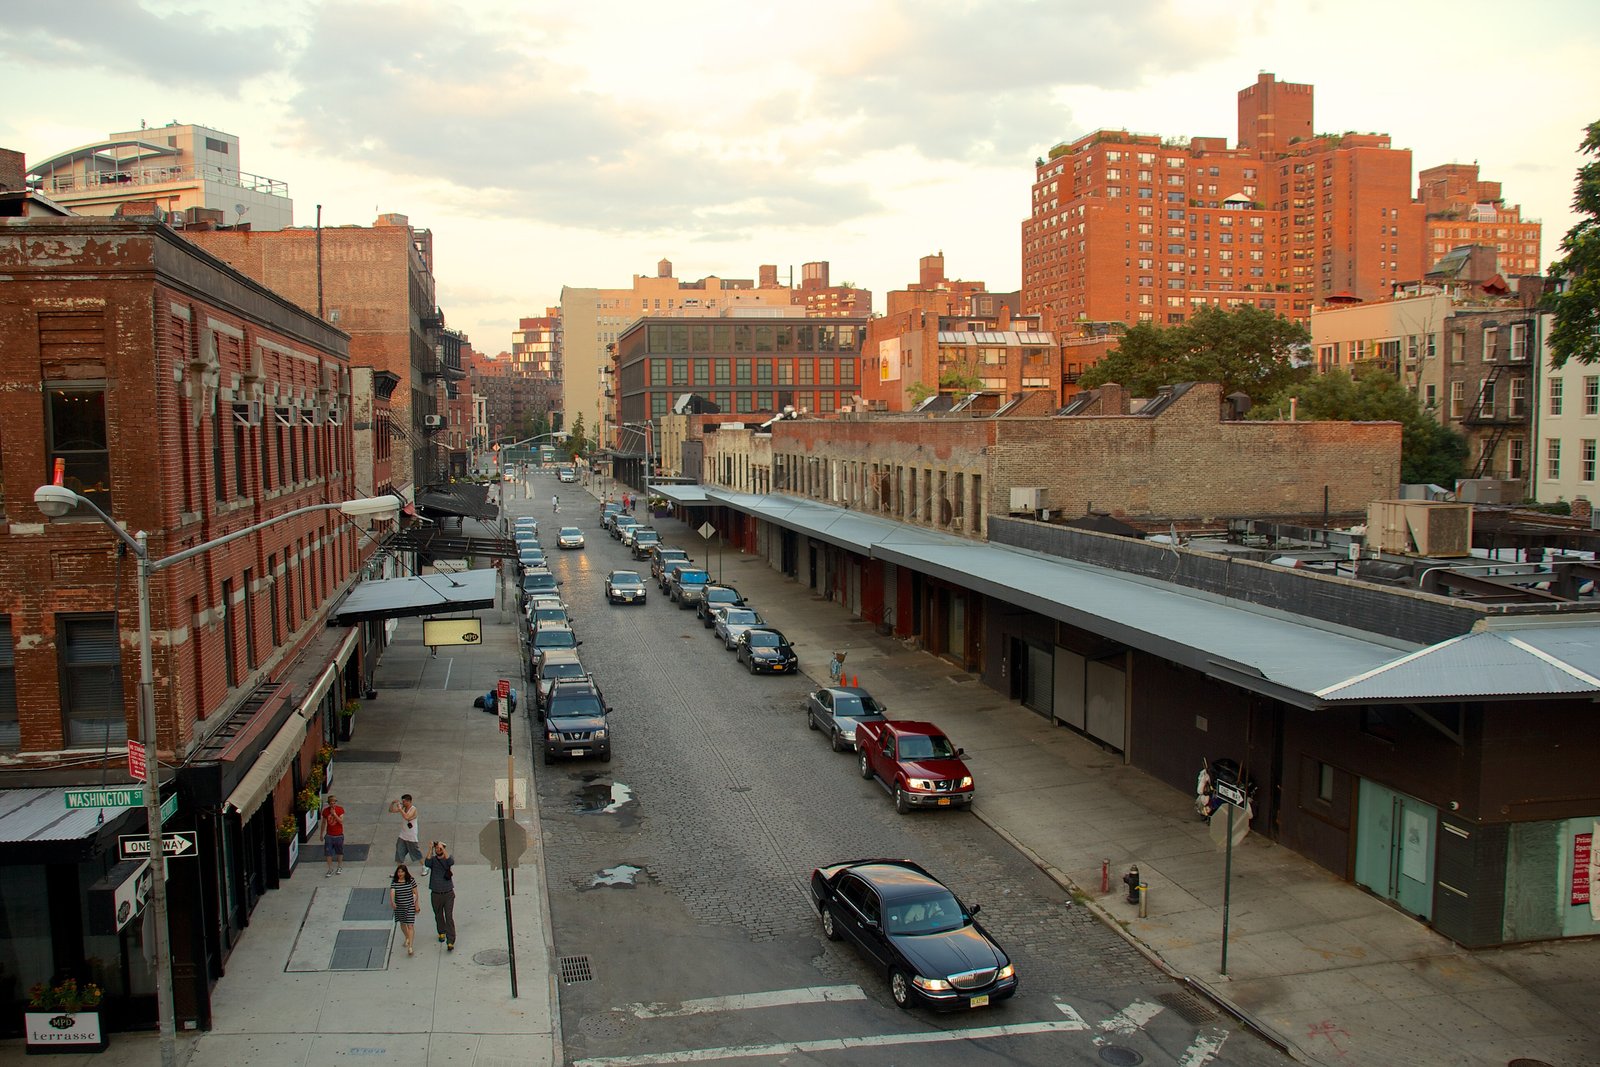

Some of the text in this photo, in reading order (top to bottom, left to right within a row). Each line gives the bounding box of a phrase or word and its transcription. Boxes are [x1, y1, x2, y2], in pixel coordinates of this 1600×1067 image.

[68, 791, 142, 807] WASHINGTON ST
[130, 840, 184, 851] ONE WAY
[52, 1018, 72, 1027] MPD
[33, 1031, 95, 1040] terrasse
